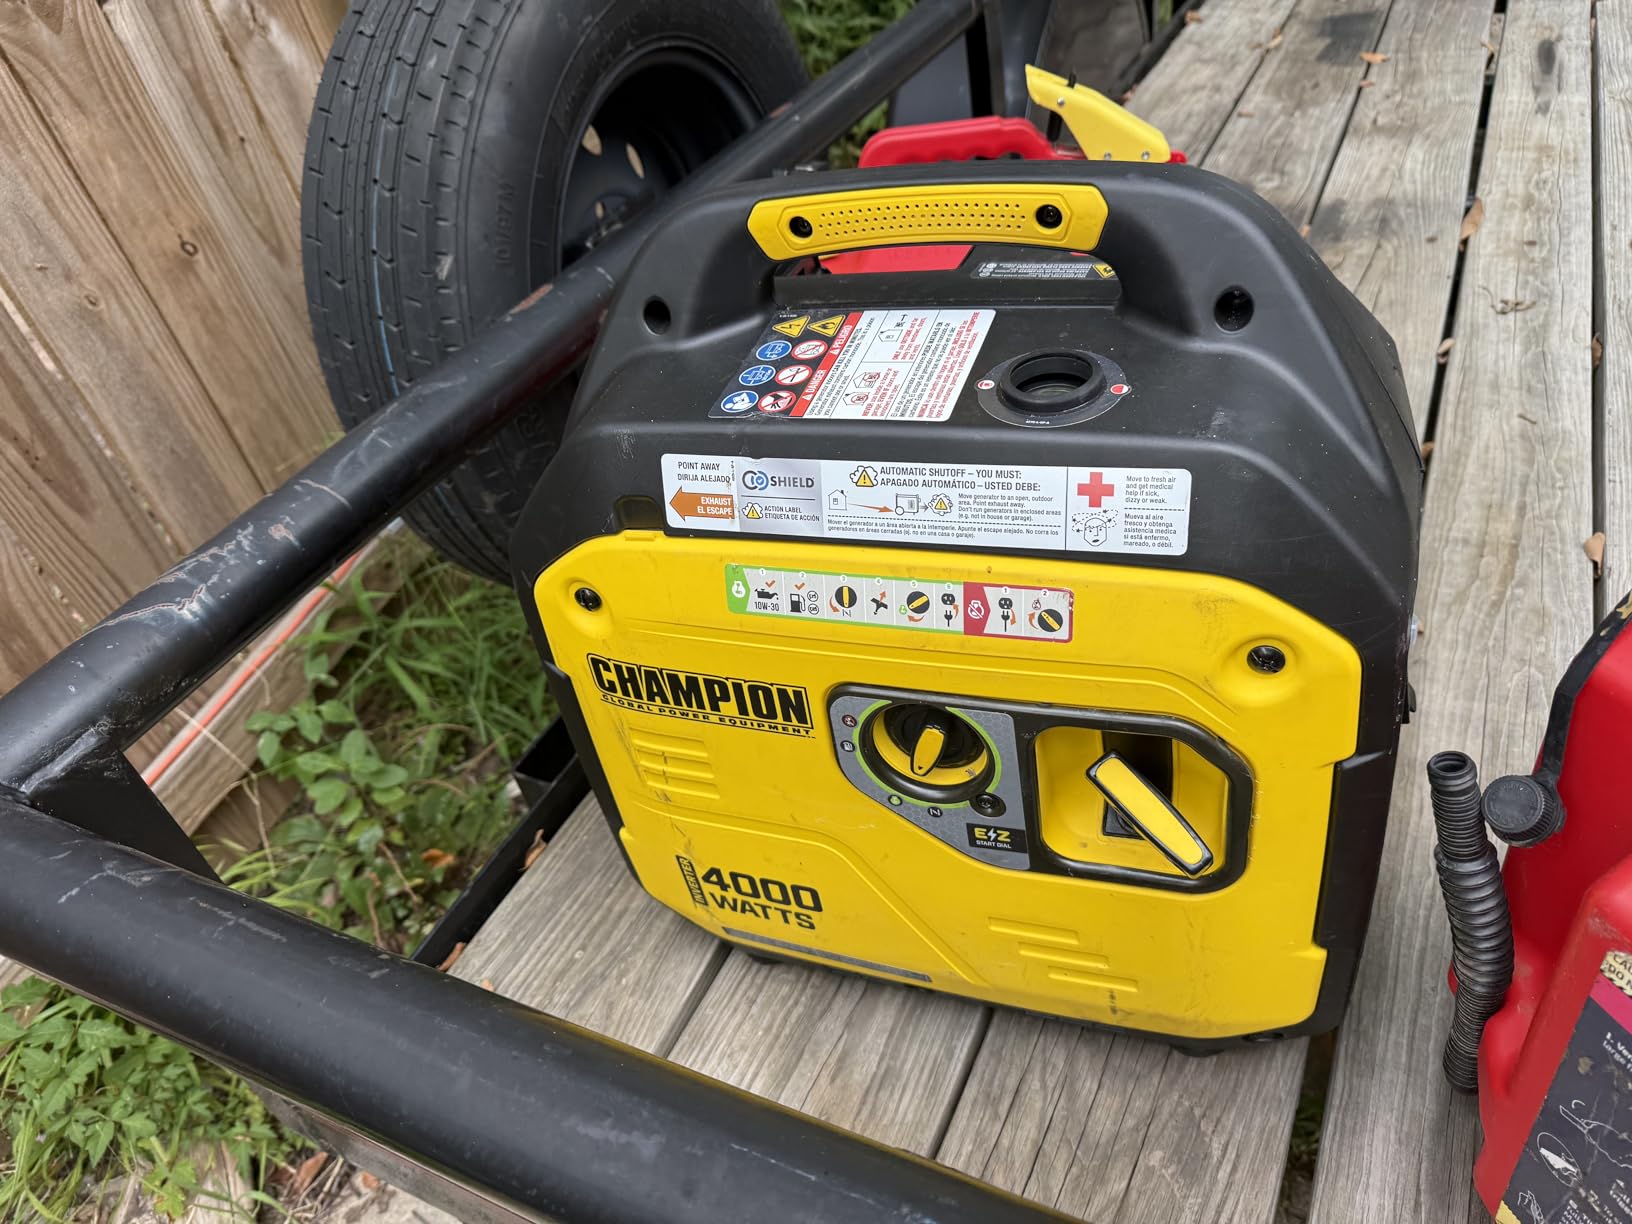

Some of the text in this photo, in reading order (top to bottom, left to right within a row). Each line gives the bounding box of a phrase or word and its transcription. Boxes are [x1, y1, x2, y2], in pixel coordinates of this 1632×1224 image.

[678, 461, 720, 470] POINT AWAY
[677, 473, 730, 483] DIRIJA ALEJADO
[880, 466, 926, 475] AUTOMATIC
[929, 467, 965, 477] SHUTOFF
[976, 469, 992, 478] YOU
[995, 470, 1021, 479] MUST:
[770, 476, 814, 488] SHIELD
[880, 477, 918, 487] APAGADO
[921, 477, 975, 489] AUTOMÁTICO
[984, 481, 1012, 490] USTED
[1015, 482, 1040, 491] DEBE:
[701, 497, 731, 505] EXHAUST
[697, 505, 732, 515] EL ESCAPE
[764, 512, 789, 520] ETIQUETA
[800, 513, 819, 521] ACCIÓN
[754, 601, 780, 612] 10W-30
[589, 655, 811, 726] CHAMPION
[602, 694, 811, 736] GLOBAL POWER EQUIPMENT
[678, 857, 706, 905] INVERTER
[701, 867, 823, 913] 4000
[709, 891, 815, 930] WATTS
